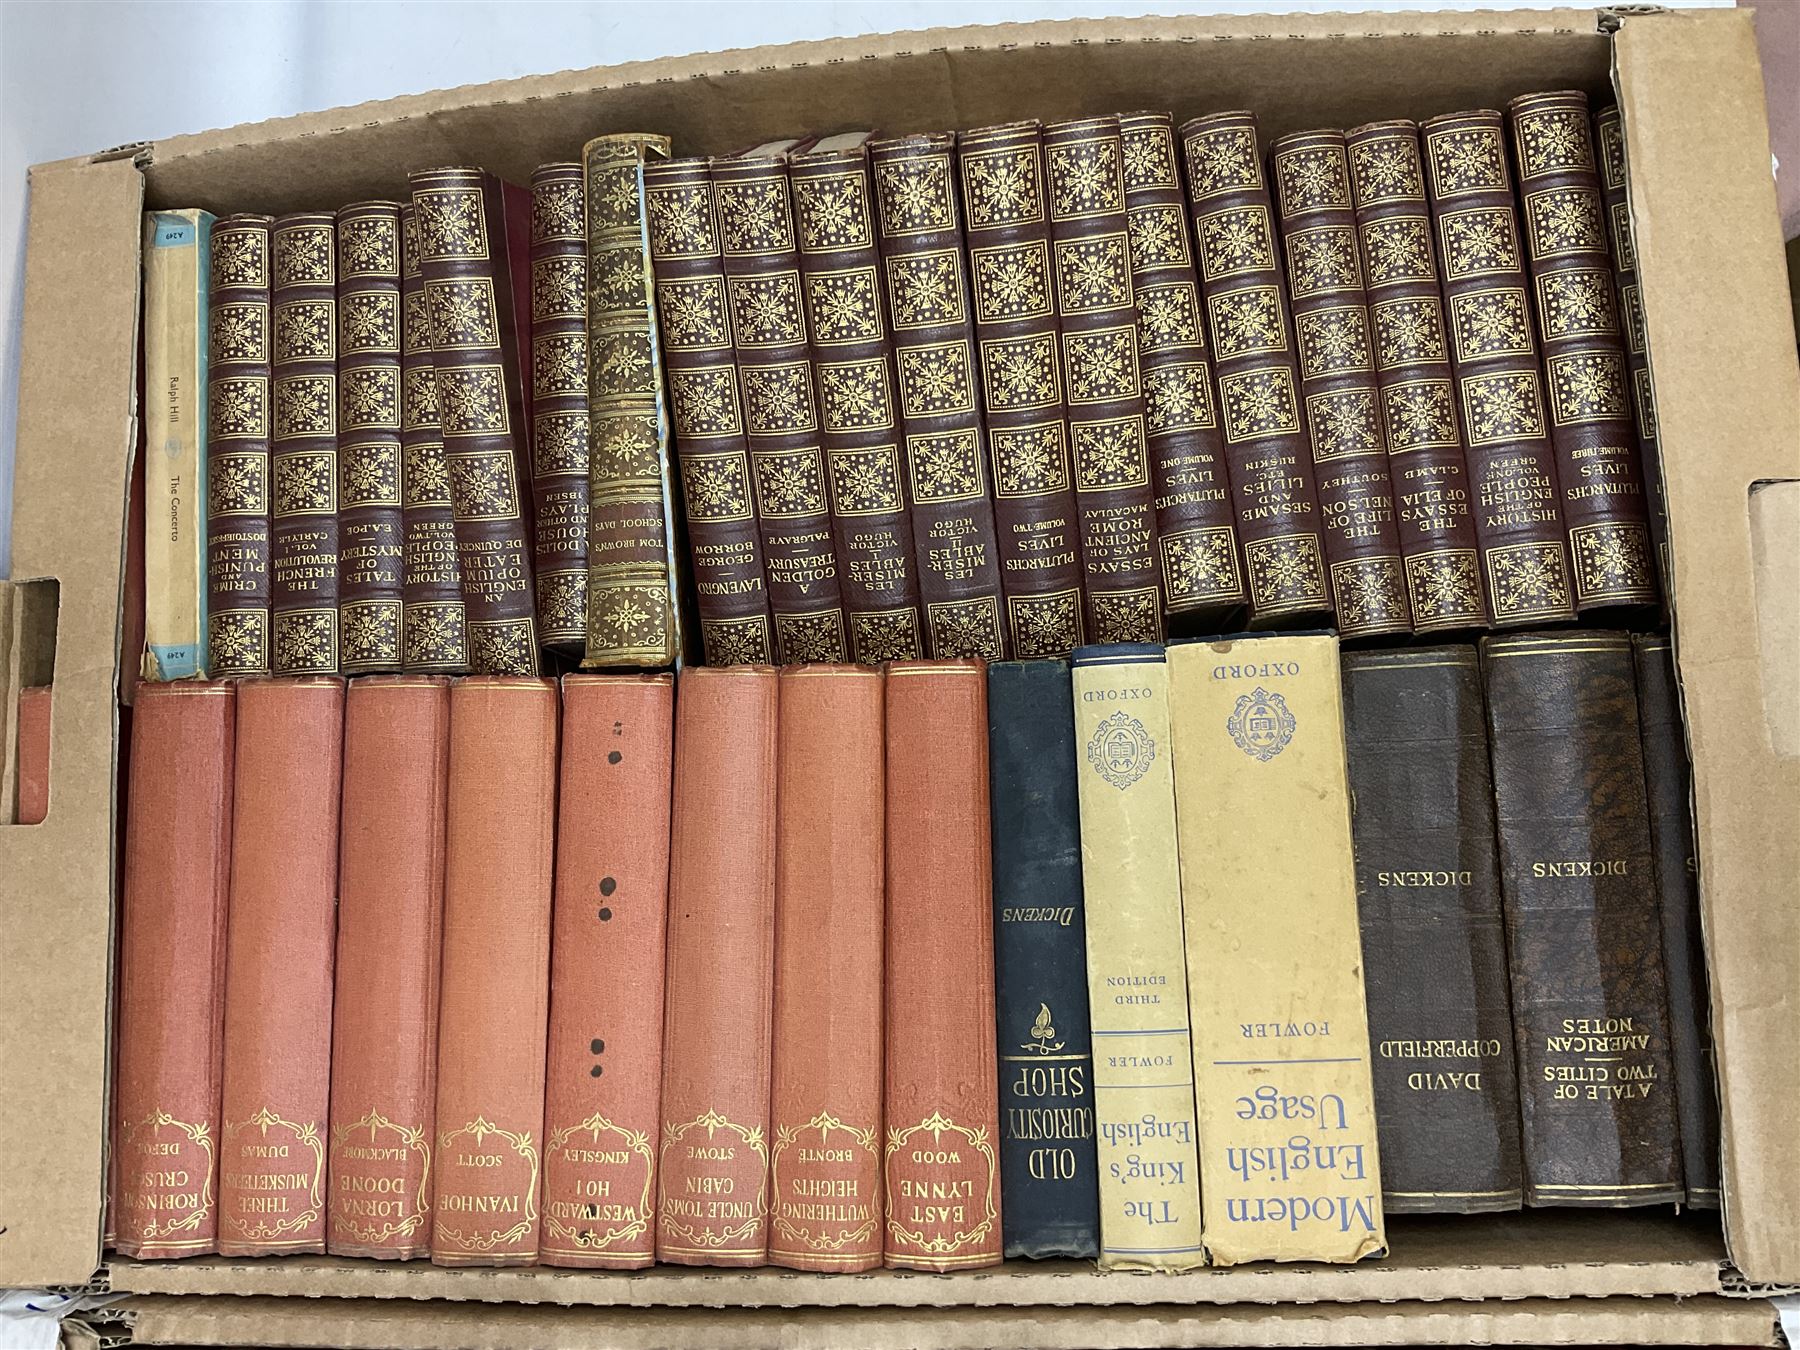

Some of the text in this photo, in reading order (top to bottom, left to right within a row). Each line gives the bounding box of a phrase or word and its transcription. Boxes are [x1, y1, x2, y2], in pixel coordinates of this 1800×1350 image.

[168, 376, 179, 423] Ralph Hill
[1571, 448, 1597, 459] THREE
[1160, 454, 1214, 469] VOLUME ONE
[1490, 457, 1536, 468] GREEN
[1580, 463, 1628, 477] LIVES
[1166, 471, 1213, 487] LIVES
[1243, 477, 1303, 496] LILIES
[1322, 473, 1388, 489] SOUTHEY
[1480, 476, 1549, 493] PEOPLE
[546, 492, 582, 501] IBSEN
[1155, 488, 1225, 509] PLUTARCH'S
[1258, 493, 1291, 503] AND
[1447, 489, 1465, 500] OF
[1481, 488, 1552, 506] ENGLISH
[1567, 482, 1639, 500] PLUTARCH'S
[171, 475, 181, 542] The Concerto
[540, 504, 589, 517] PLAYS
[1084, 504, 1148, 518] MACAULAY
[1242, 502, 1311, 521] SESAME
[1322, 497, 1392, 516] NELSON
[1401, 504, 1468, 521] ESSAYS
[1497, 503, 1524, 512] THE
[595, 518, 663, 530] SCHOOL DAYS
[935, 518, 973, 529] HUGO
[1090, 518, 1142, 533] ROME
[1328, 510, 1391, 529] LIFE OF
[1419, 518, 1456, 531] THE
[1486, 509, 1556, 527] HISTORY
[929, 526, 978, 537] VICTOR
[1013, 523, 1033, 532] TWO
[1344, 525, 1380, 538] THE
[279, 532, 328, 543] CARLYLE
[640, 539, 663, 548] TOM
[768, 532, 830, 544] PALGRAVE
[855, 532, 892, 541] HUGO
[1018, 535, 1063, 551] LIVES
[1085, 529, 1151, 547] ANCIENT
[405, 541, 458, 552] EOPLE
[458, 539, 522, 551] DE QUINCEY
[595, 540, 635, 552] BROWN'S
[695, 542, 754, 554] BORROW
[849, 540, 898, 549] VICTOR
[929, 544, 985, 559] ABLES
[1090, 543, 1148, 557] LAYS OF
[213, 549, 259, 561] MENT
[340, 545, 403, 560] MYSTERY
[405, 552, 459, 565] NGLISH
[698, 554, 753, 566] GEORGE
[274, 555, 337, 568] REVOLUTION
[356, 559, 377, 569] OF
[464, 554, 521, 568] EATER
[768, 553, 835, 569] TREASURY
[850, 557, 905, 571] ABLES
[927, 555, 985, 571] MISER-
[1006, 552, 1074, 570] PLUTARCH'S
[1088, 557, 1152, 573] ESSAYS
[278, 567, 335, 581] FRENCH
[346, 571, 395, 584] TALES
[466, 567, 520, 580] OPIUM
[772, 567, 835, 582] GOLDEN
[849, 568, 905, 581] MISER-
[945, 569, 973, 580] LES
[213, 581, 256, 592] CRIME
[288, 581, 318, 591] THE
[464, 580, 526, 593] ENGLISH
[698, 578, 761, 595] LAVENGRO
[800, 584, 809, 594] A
[865, 581, 894, 591] LES
[485, 594, 504, 602] AN
[1213, 662, 1299, 680] OXFORD
[1083, 688, 1152, 702] OXFORD
[1532, 859, 1627, 877] DICKENS
[1377, 870, 1472, 886] DICKENS
[1106, 975, 1166, 987] EDITION
[1114, 994, 1160, 1006] THIRD
[1239, 1020, 1330, 1038] FOWLER
[1562, 1017, 1633, 1033] NOTES
[1379, 1039, 1501, 1058] COPPERFIELD
[1546, 1035, 1650, 1052] AMERICAN
[1107, 1055, 1173, 1068] FOWLER
[1543, 1064, 1657, 1081] TWO CITIES
[1013, 1065, 1084, 1097] SHOP
[1407, 1072, 1481, 1090] DAVID
[1553, 1083, 1653, 1099] A TALE OF
[1234, 1086, 1349, 1130] Usage
[1008, 1106, 1093, 1139] CURIOSITY
[1101, 1114, 1190, 1146] English
[241, 1146, 288, 1157] DUMAS
[342, 1147, 406, 1160] BLACKMORE
[563, 1149, 629, 1163] KINGSLEY
[687, 1146, 735, 1160] STOWE
[798, 1148, 853, 1163] BRONTË
[912, 1150, 961, 1163] WOOD
[1225, 1135, 1367, 1180] English
[456, 1154, 503, 1167] SCOTT
[1028, 1148, 1076, 1179] OLD
[1109, 1154, 1185, 1184] King's
[226, 1173, 308, 1189] MUSKETEERS
[341, 1176, 405, 1194] DOONE
[686, 1177, 734, 1194] CABIN
[793, 1179, 858, 1197] HEIGHTS
[900, 1180, 973, 1198] LYNNE
[239, 1197, 289, 1213] THREE
[342, 1198, 403, 1217] LORNA
[441, 1195, 519, 1213] IVANHOE
[551, 1201, 637, 1221] WESTWARD
[708, 1201, 753, 1218] UNCLE
[782, 1202, 869, 1220] WUTHERING
[910, 1205, 964, 1222] EAST
[1123, 1200, 1179, 1225] The
[1225, 1195, 1375, 1232] Modern
